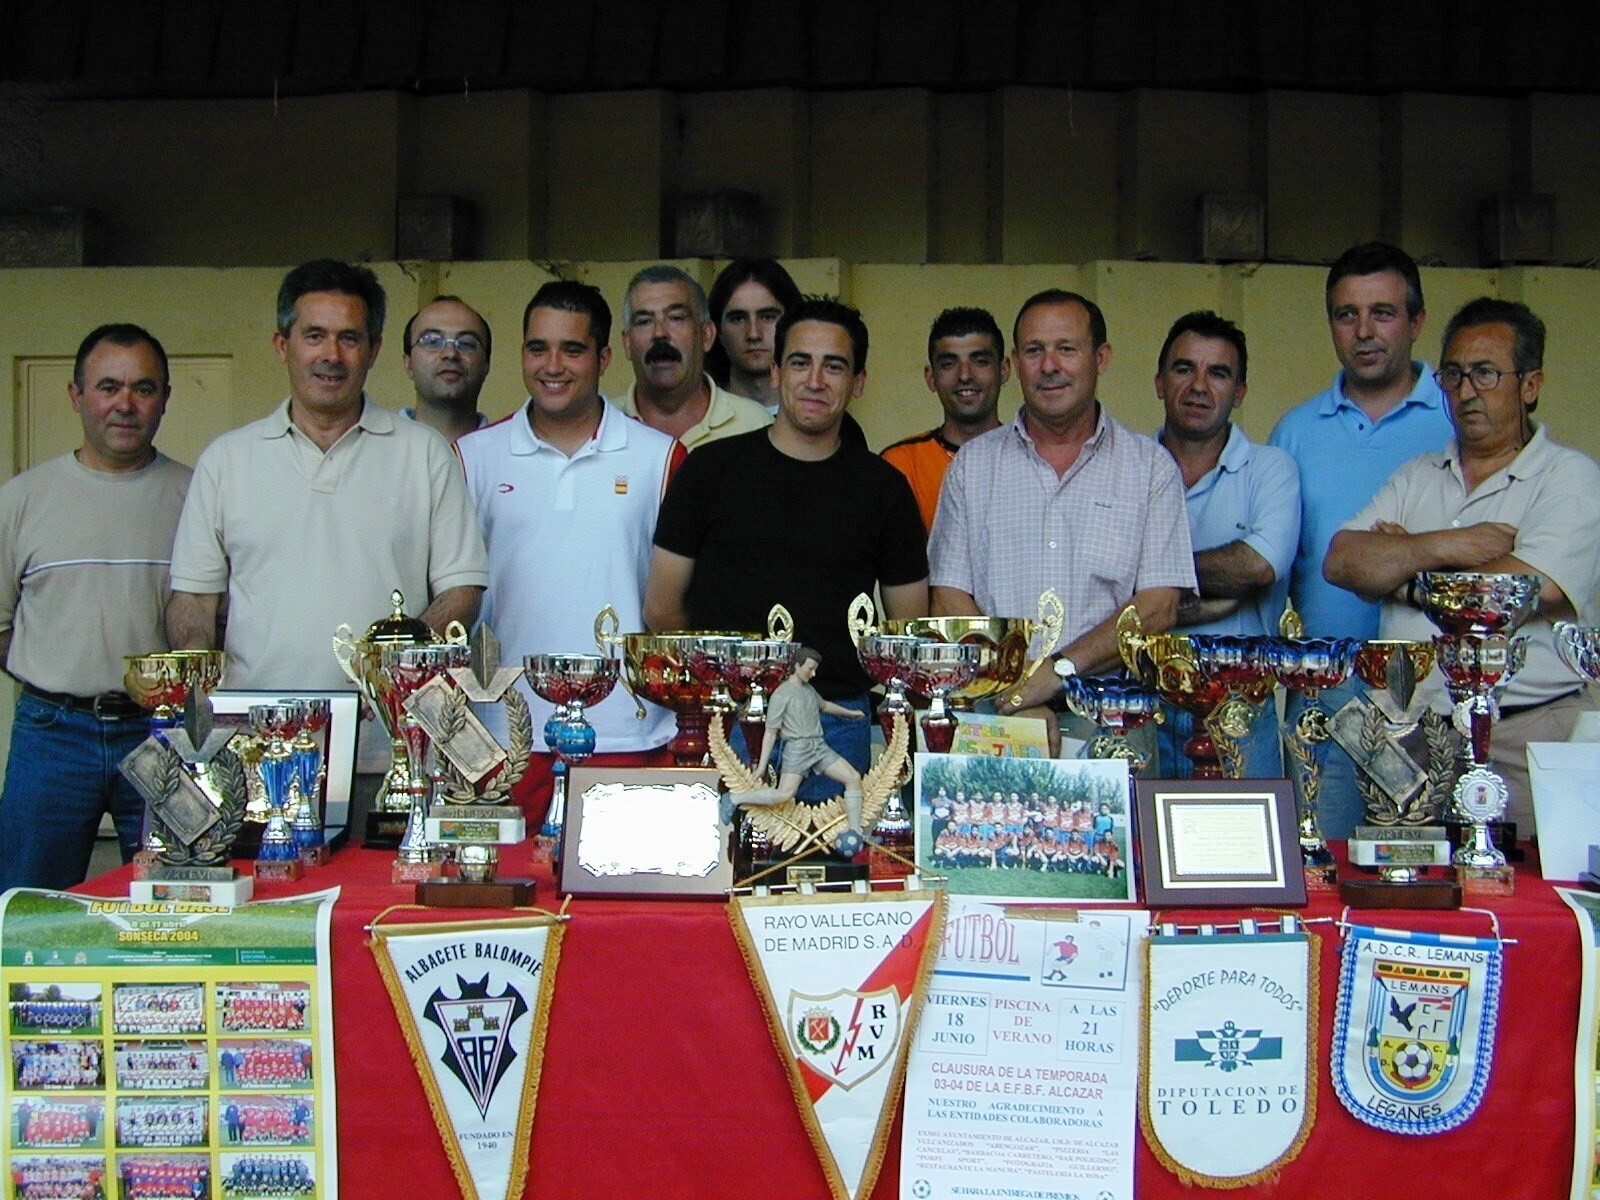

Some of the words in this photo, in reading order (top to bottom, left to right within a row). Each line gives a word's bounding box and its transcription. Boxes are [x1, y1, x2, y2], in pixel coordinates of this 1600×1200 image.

[764, 914, 807, 929] RAYO
[811, 911, 913, 928] VALLECANO
[118, 930, 168, 942] SONSECA
[169, 930, 199, 942] 2004
[764, 938, 787, 951] DE
[793, 935, 859, 950] MADRID
[405, 943, 467, 983] ALBACETE
[1427, 949, 1484, 963] LEMANS
[1220, 969, 1256, 986] PARA
[1390, 980, 1451, 995] LEMANS
[926, 994, 987, 1008] VIERNES
[995, 998, 1051, 1013] PISCINA
[872, 1004, 887, 1019] R
[1069, 1005, 1079, 1015] A
[1090, 1005, 1118, 1017] LAS
[947, 1013, 964, 1027] 18
[1013, 1015, 1033, 1027] DE
[869, 1025, 884, 1039] V
[1082, 1021, 1099, 1036] 21
[932, 1031, 976, 1045] JUNIO
[993, 1030, 1052, 1044] VERANO
[857, 1045, 875, 1061] M
[1065, 1039, 1114, 1053] HORAS
[931, 1062, 995, 1077] CLAUSURA
[999, 1066, 1014, 1078] DE
[1017, 1067, 1032, 1079] LA
[1035, 1068, 1108, 1084] TEMPORADA
[934, 1078, 963, 1090] 03-04
[966, 1080, 982, 1092] DE
[985, 1081, 1000, 1093] LA
[1048, 1085, 1103, 1100] ALCAZAR
[1157, 1086, 1267, 1098] DIPUTACION
[1278, 1085, 1298, 1096] DE
[928, 1097, 977, 1108] NUESTRO
[989, 1102, 1084, 1115] AGRADECIMIENTO
[1157, 1097, 1297, 1116] TOLEDO
[1366, 1095, 1442, 1120] LEGANES
[927, 1109, 947, 1118] LAS
[950, 1110, 1008, 1122] ENTIDADES
[1010, 1114, 1103, 1128] COLABORADORAS
[460, 1131, 500, 1140] FUNDADO
[477, 1141, 497, 1150] 1940
